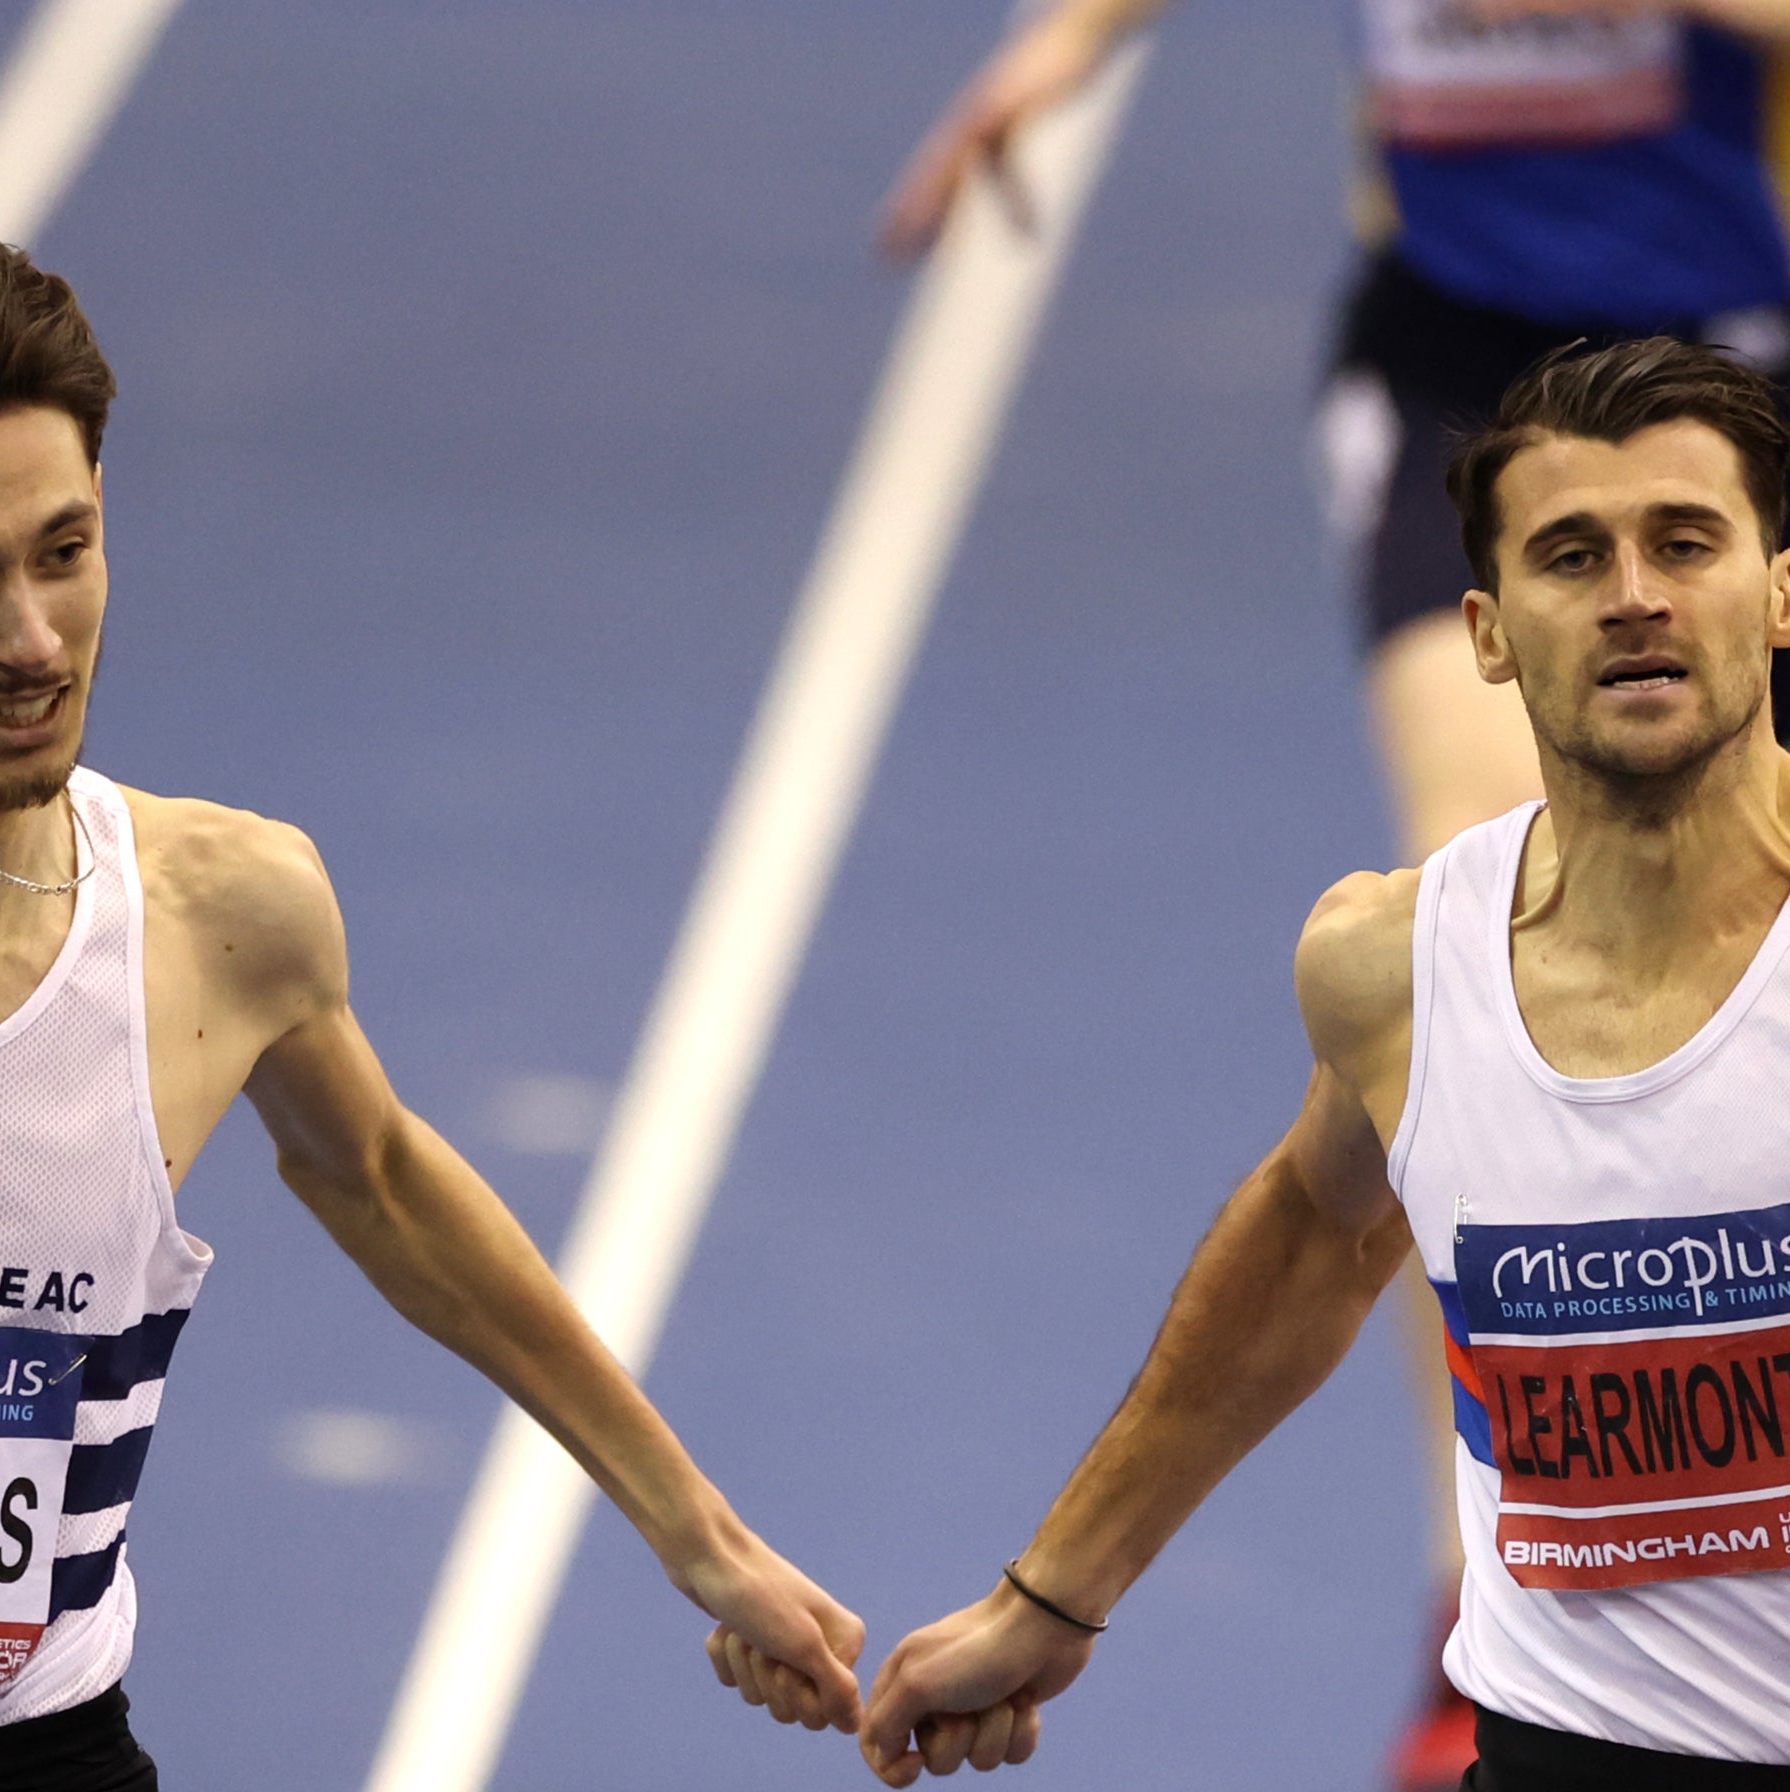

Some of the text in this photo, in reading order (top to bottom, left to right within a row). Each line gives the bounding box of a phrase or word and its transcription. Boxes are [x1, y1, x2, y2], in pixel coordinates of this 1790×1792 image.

[36, 1271, 94, 1314] AC
[1500, 1299, 1547, 1320] DATA
[1553, 1291, 1691, 1318] PROCESSING
[1704, 1288, 1720, 1307] &
[1502, 1524, 1771, 1569] BIRMINGHAM
